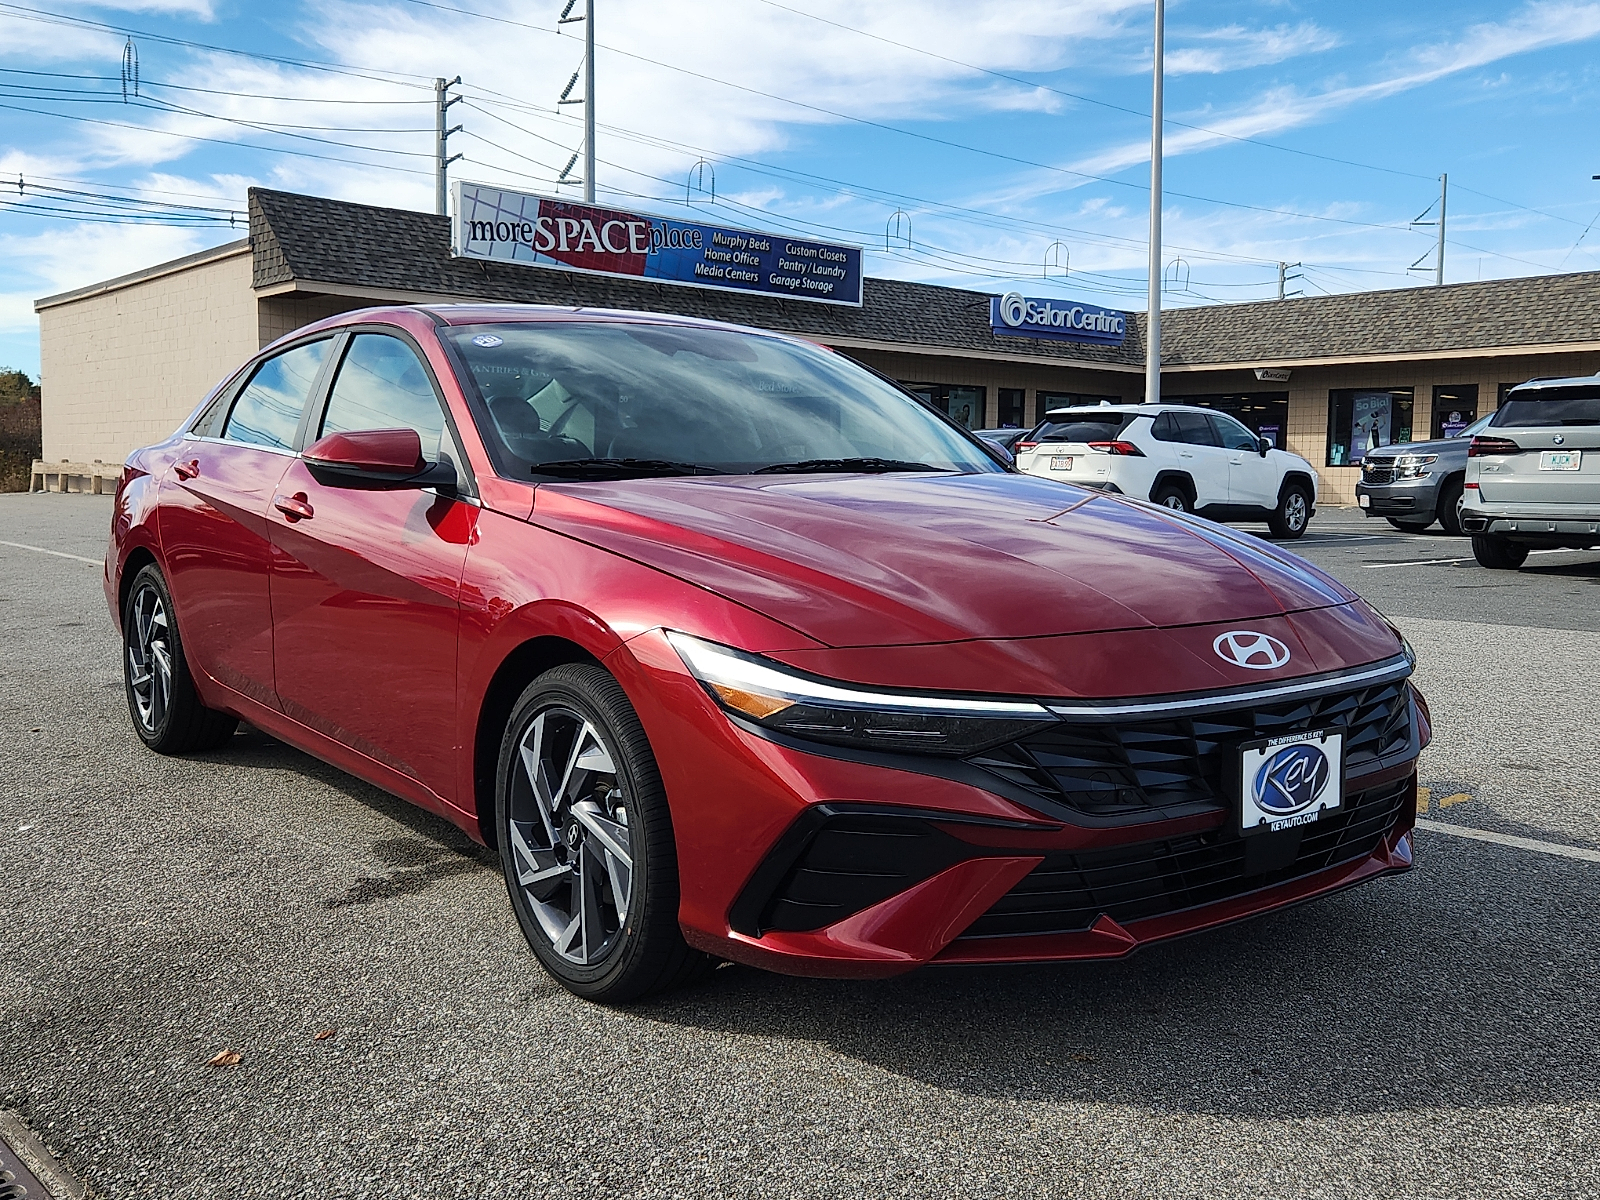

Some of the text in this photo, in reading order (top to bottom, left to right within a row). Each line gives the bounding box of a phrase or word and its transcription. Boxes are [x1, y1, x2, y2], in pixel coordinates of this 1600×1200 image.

[470, 216, 703, 256] more SPACE place
[712, 231, 770, 251] Murphy Beds
[704, 247, 760, 266] Home Office
[785, 243, 847, 263] Custom Closets
[695, 263, 759, 282] Media Centers
[778, 258, 808, 274] Pantry
[813, 263, 846, 280] Laundry
[769, 273, 834, 293] Garage Storage
[1025, 301, 1123, 334] SalonCentric
[1356, 402, 1369, 411] So
[1279, 733, 1307, 745] DIFFERENCE
[1259, 750, 1323, 807] Key
[1270, 812, 1319, 832] KEYAUTO.COM
